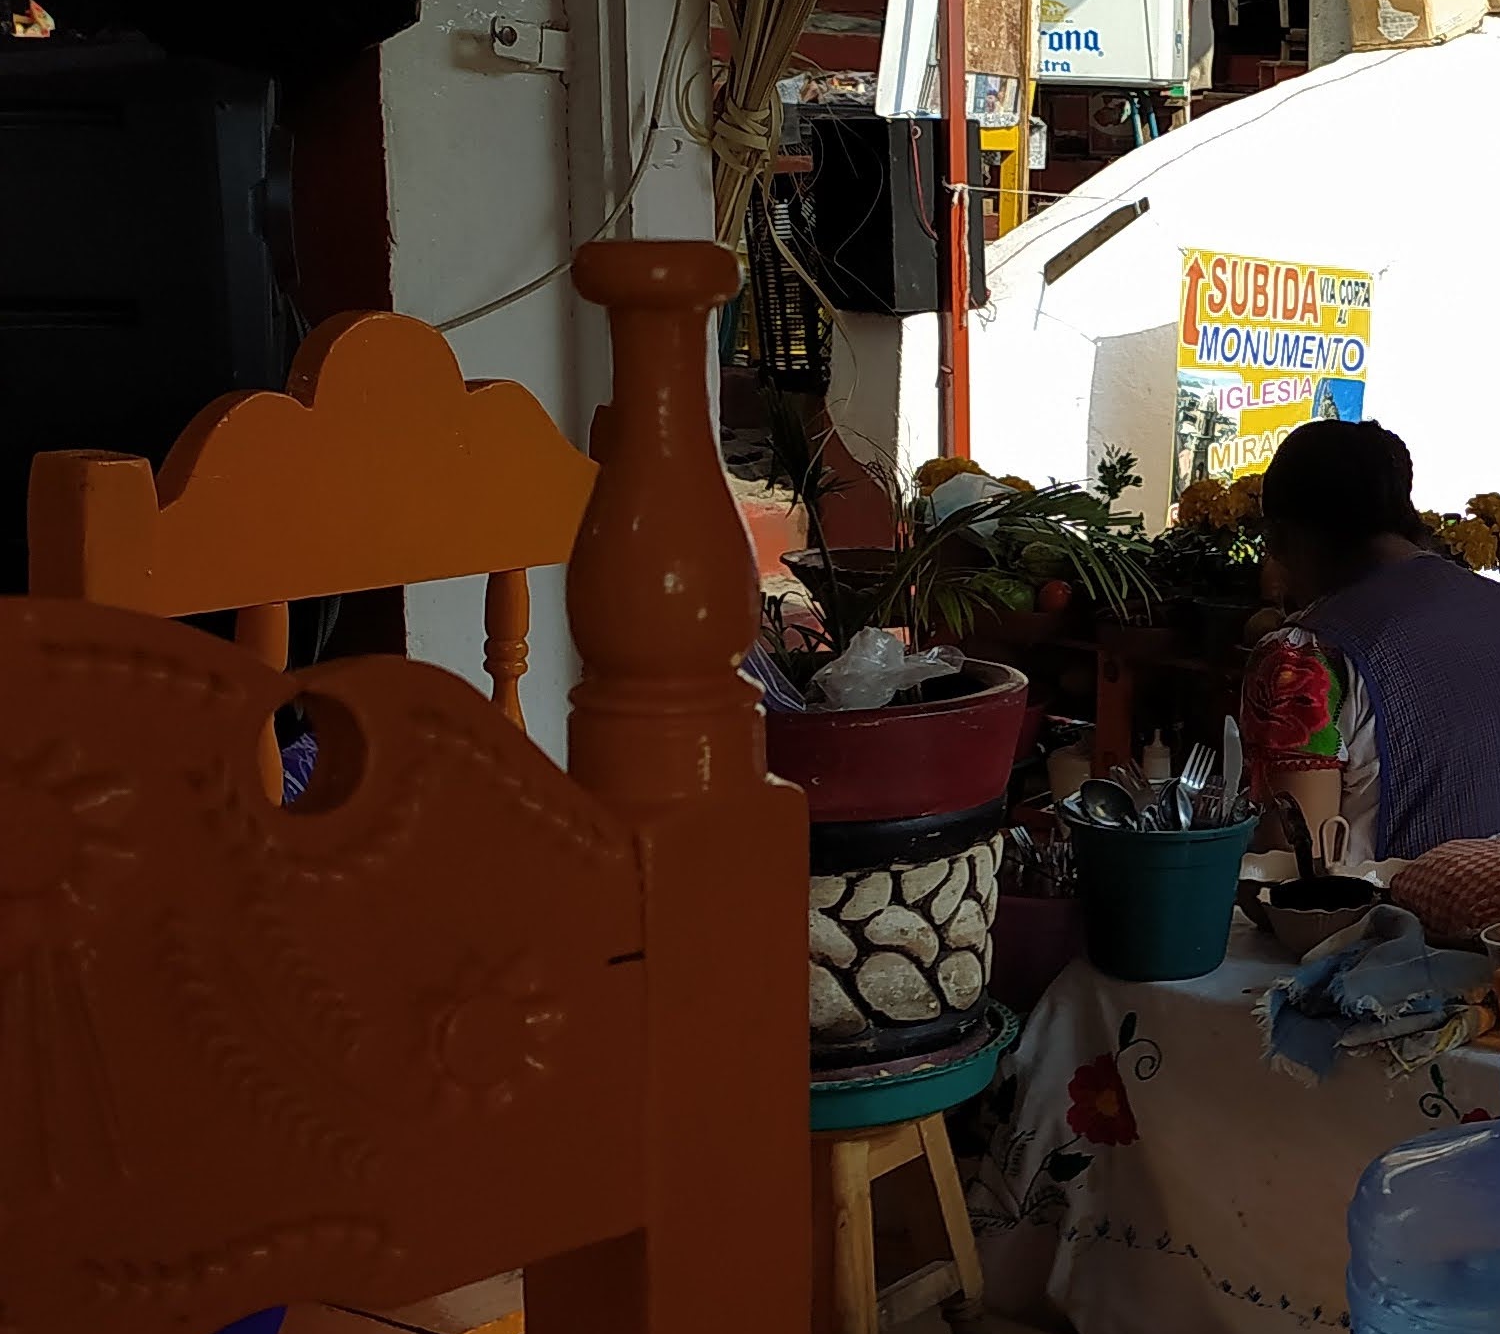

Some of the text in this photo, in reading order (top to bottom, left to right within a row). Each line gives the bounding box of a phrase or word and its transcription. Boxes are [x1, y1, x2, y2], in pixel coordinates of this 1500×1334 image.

[1208, 257, 1319, 324] SUBIDA
[1199, 325, 1365, 371] MONUMENTO
[1219, 378, 1313, 411] IGLESIA
